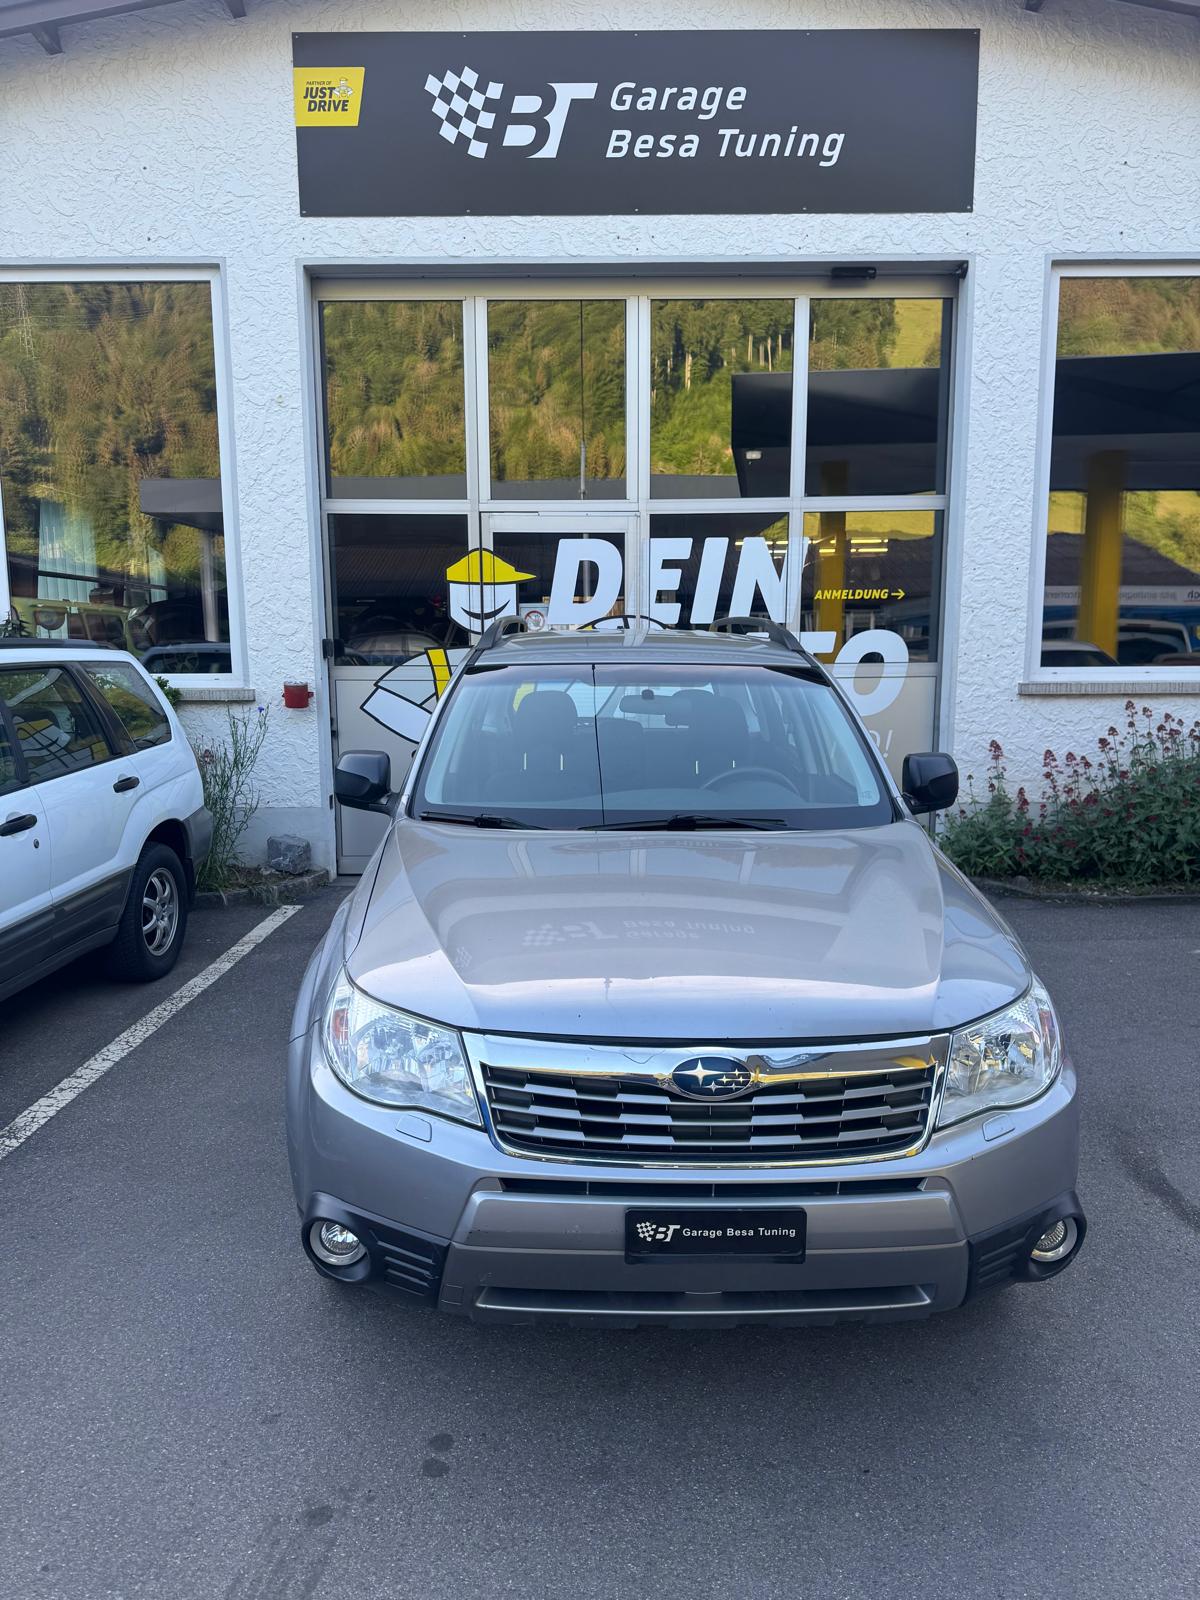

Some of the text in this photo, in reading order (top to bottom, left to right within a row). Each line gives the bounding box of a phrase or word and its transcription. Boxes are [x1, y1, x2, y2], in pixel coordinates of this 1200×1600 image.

[303, 86, 336, 99] JUST
[307, 99, 350, 112] DRIVE
[609, 81, 748, 120] Garage
[502, 82, 598, 159] BT
[605, 125, 846, 167] Besa Tuning
[547, 536, 810, 625] DEIN
[814, 588, 890, 600] ANMELDUNG
[655, 1224, 796, 1242] BT Garage Besa Tuning
